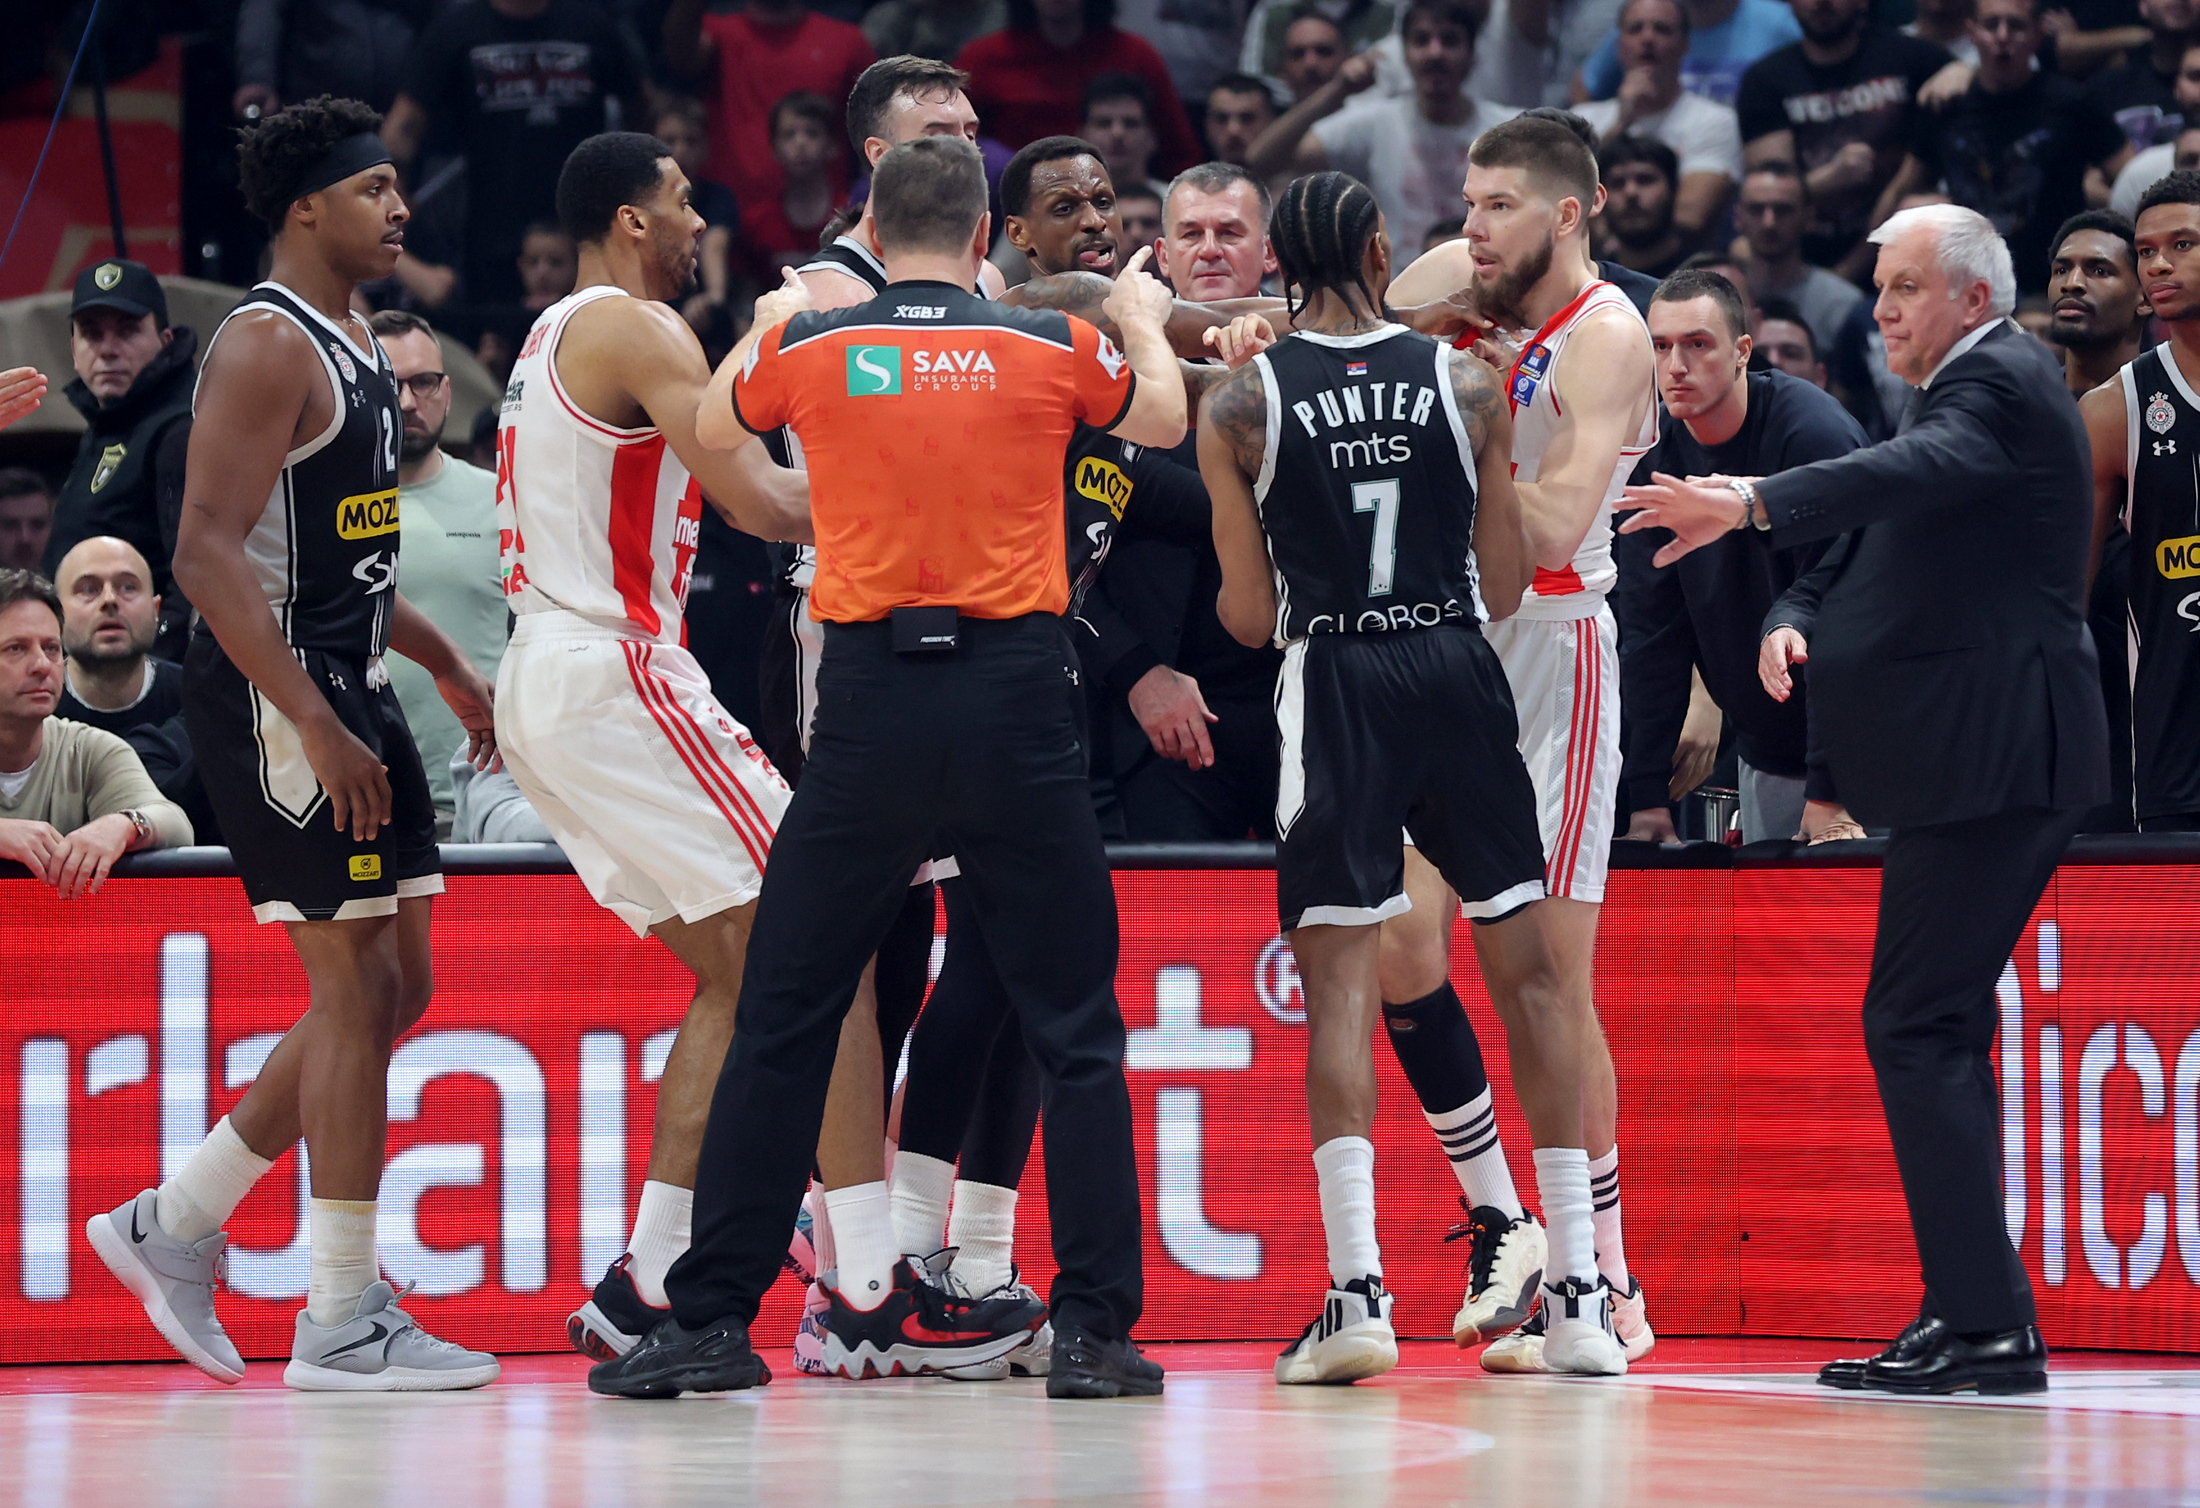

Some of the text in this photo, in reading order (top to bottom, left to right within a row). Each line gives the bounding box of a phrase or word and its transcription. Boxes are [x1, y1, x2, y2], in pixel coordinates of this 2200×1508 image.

[912, 350, 996, 373] SAVA
[914, 375, 996, 383] INSURANCE
[1292, 382, 1436, 439] PUNTER
[381, 406, 396, 472] 2
[1330, 432, 1412, 469] mts
[1350, 477, 1400, 598] 7
